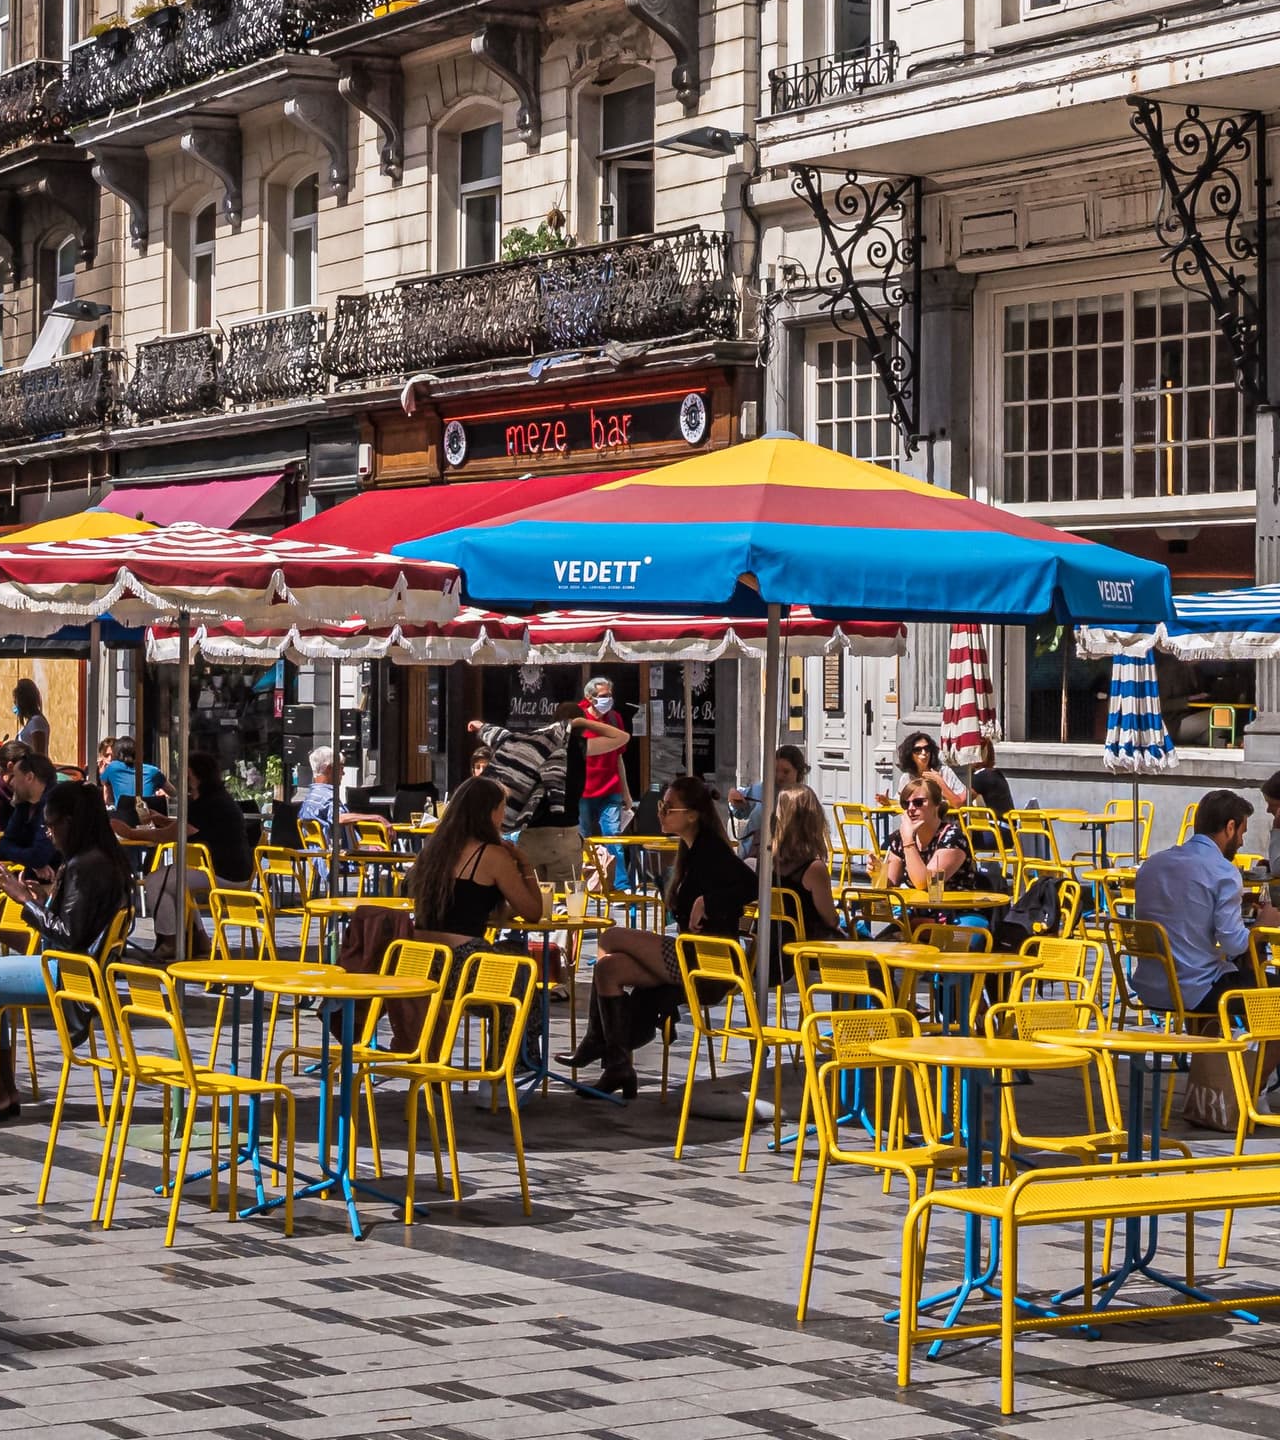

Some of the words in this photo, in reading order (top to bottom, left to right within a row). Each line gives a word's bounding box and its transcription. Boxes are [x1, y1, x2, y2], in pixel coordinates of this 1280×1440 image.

[505, 420, 567, 456] meze
[590, 408, 632, 450] bar
[553, 560, 642, 583] VEDETT
[1097, 580, 1133, 603] VEDETT
[510, 696, 537, 716] Meze
[667, 699, 700, 720] Mee
